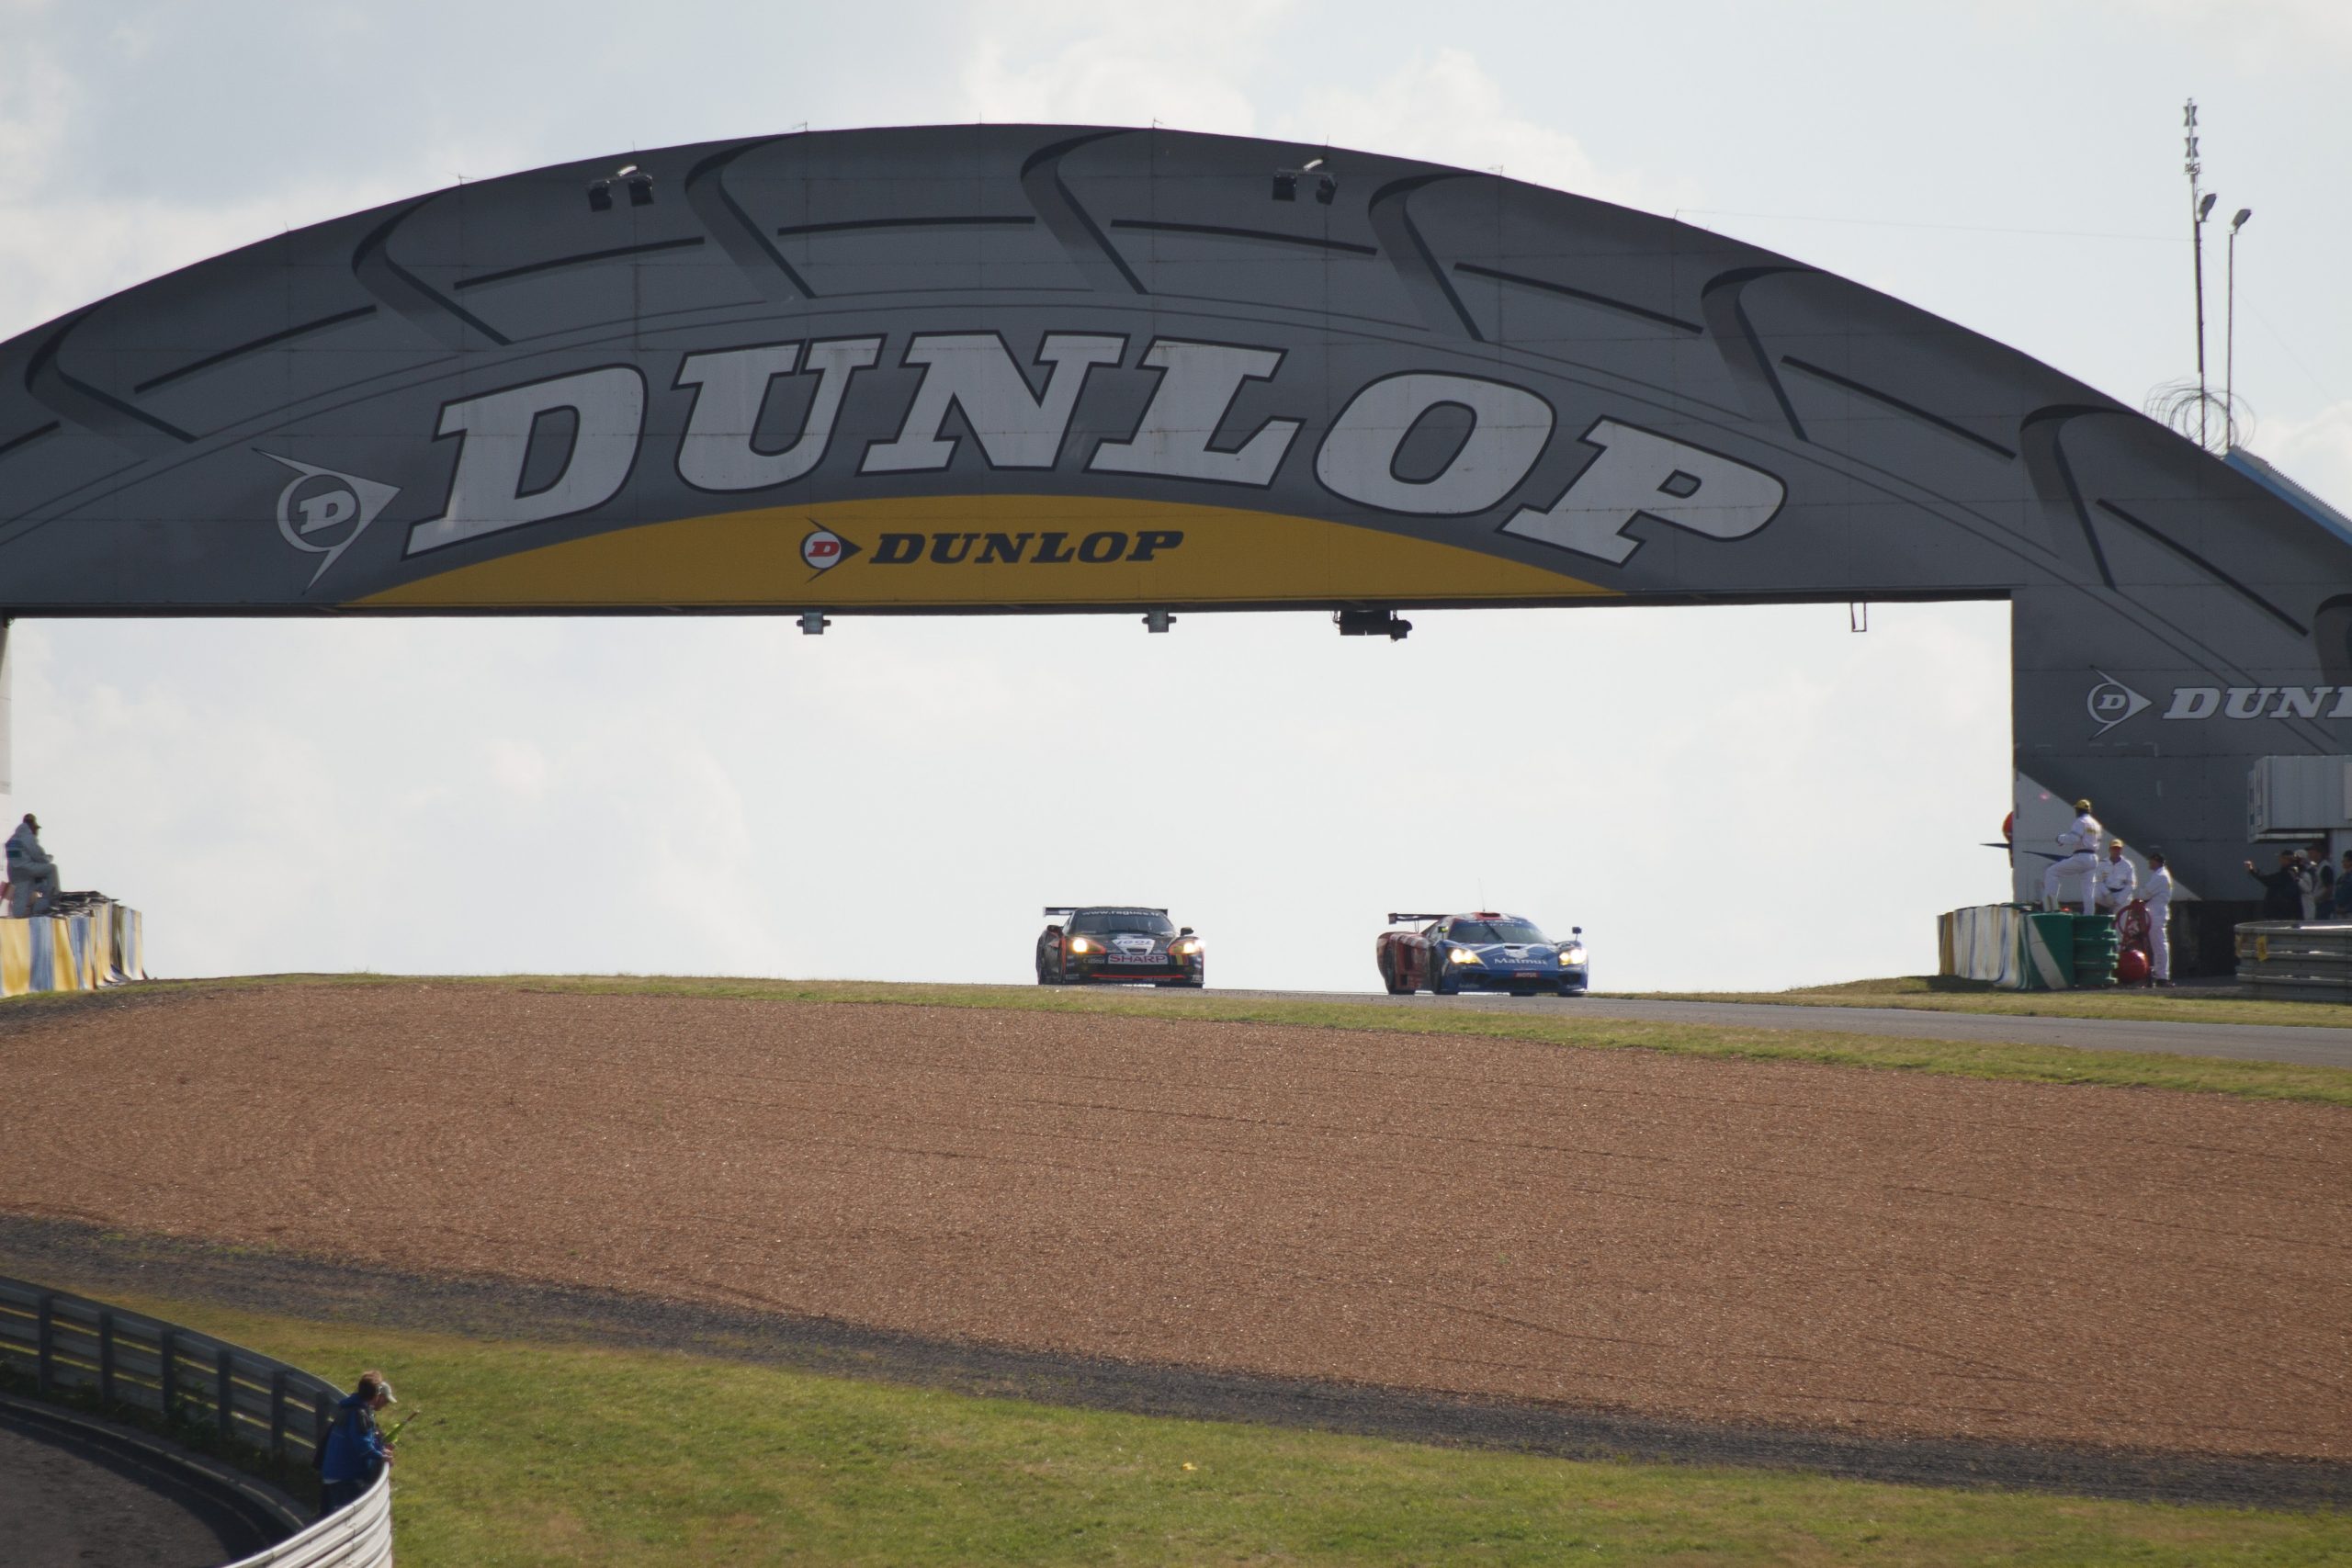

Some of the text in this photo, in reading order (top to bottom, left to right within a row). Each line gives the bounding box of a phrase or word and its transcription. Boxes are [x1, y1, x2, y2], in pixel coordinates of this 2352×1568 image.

[404, 331, 1786, 566] DUNLOP
[298, 490, 356, 536] D
[807, 541, 841, 558] D
[868, 533, 1183, 565] DUNLOP
[2098, 694, 2127, 710] D
[1109, 954, 1166, 964] SHARP
